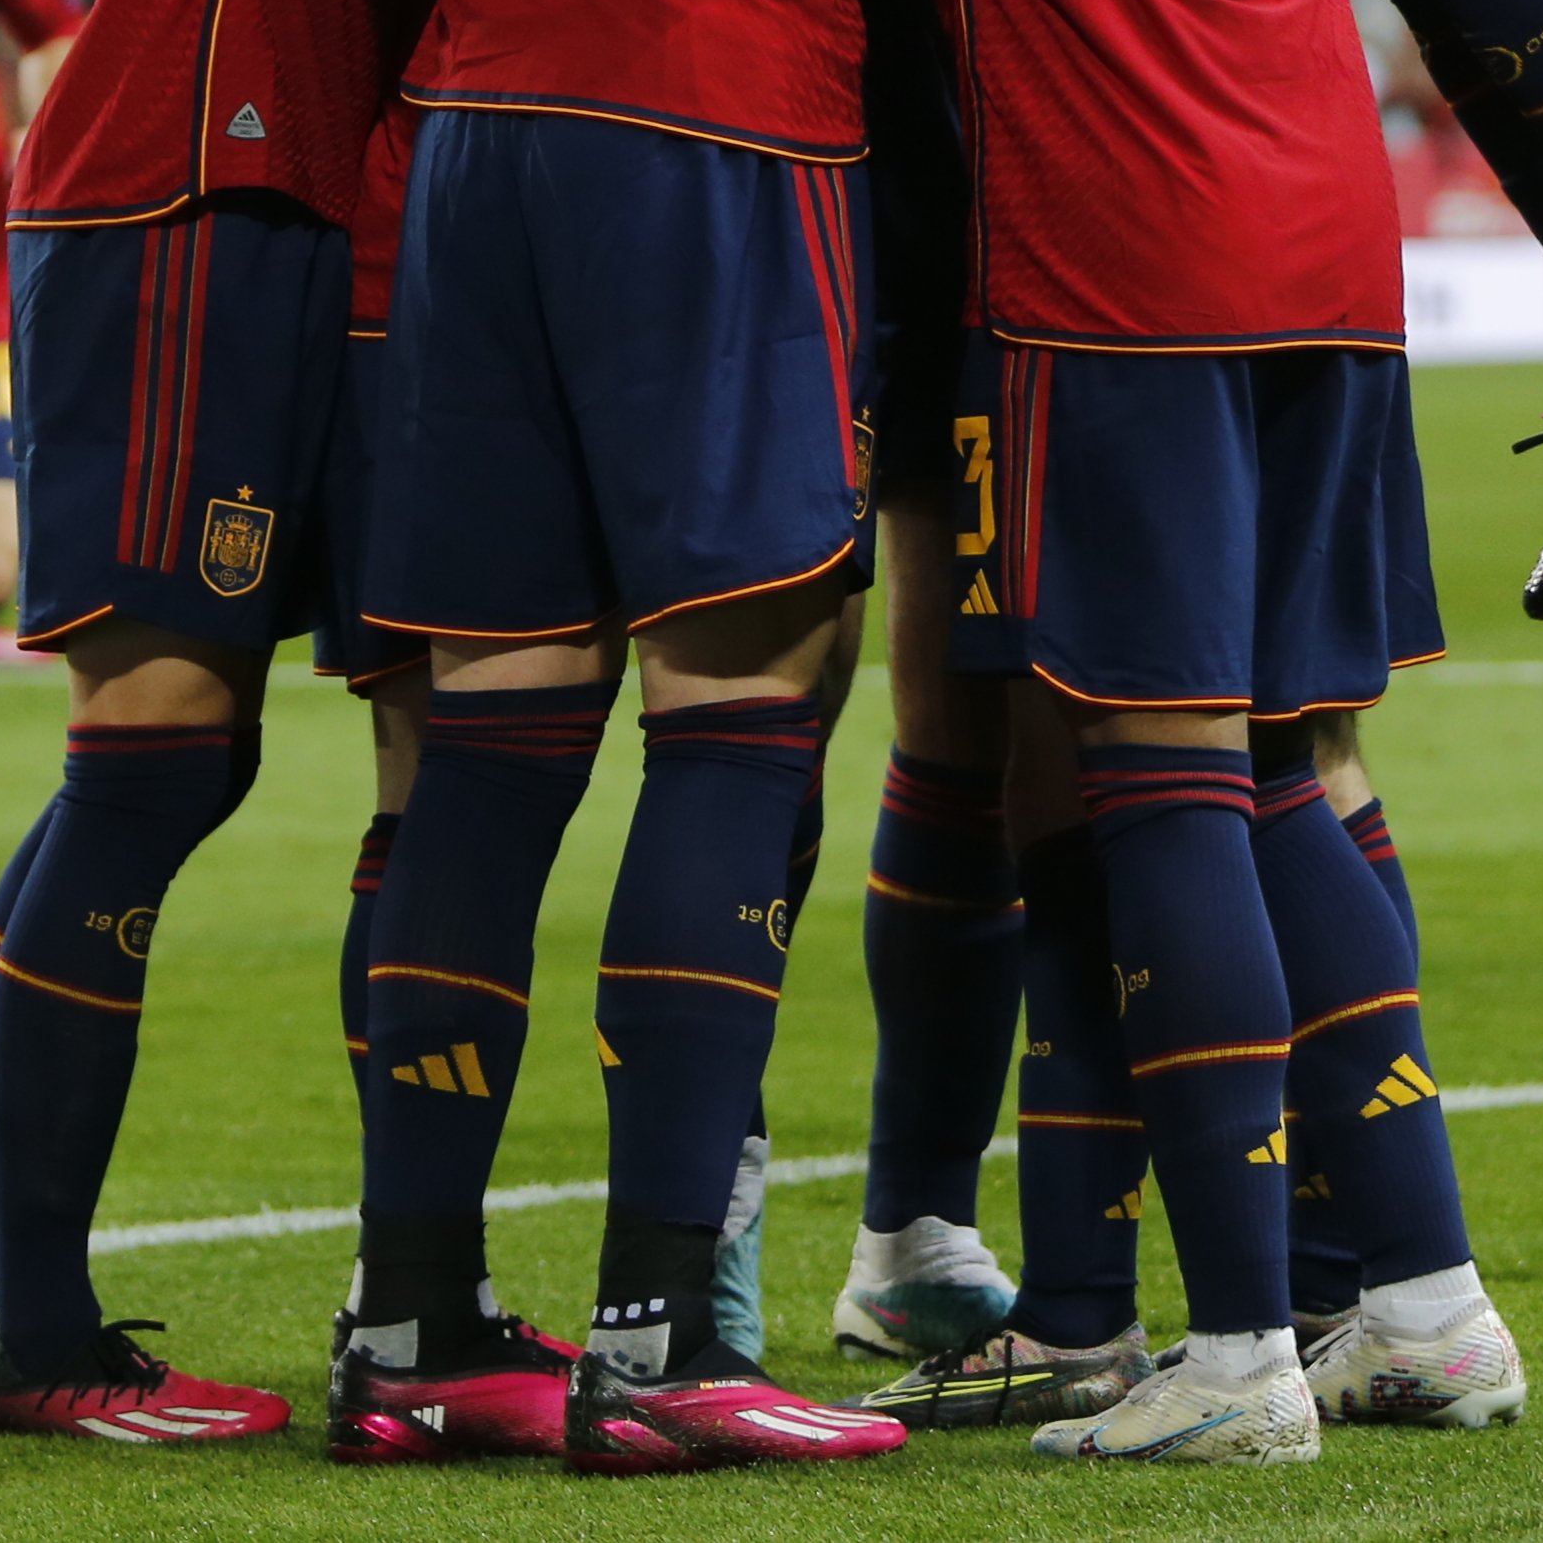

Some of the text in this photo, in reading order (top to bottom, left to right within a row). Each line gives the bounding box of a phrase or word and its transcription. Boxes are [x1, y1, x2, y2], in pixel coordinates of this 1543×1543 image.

[953, 415, 996, 557] 3
[83, 910, 113, 931] 19
[737, 904, 763, 923] 19
[1128, 967, 1151, 993] 09
